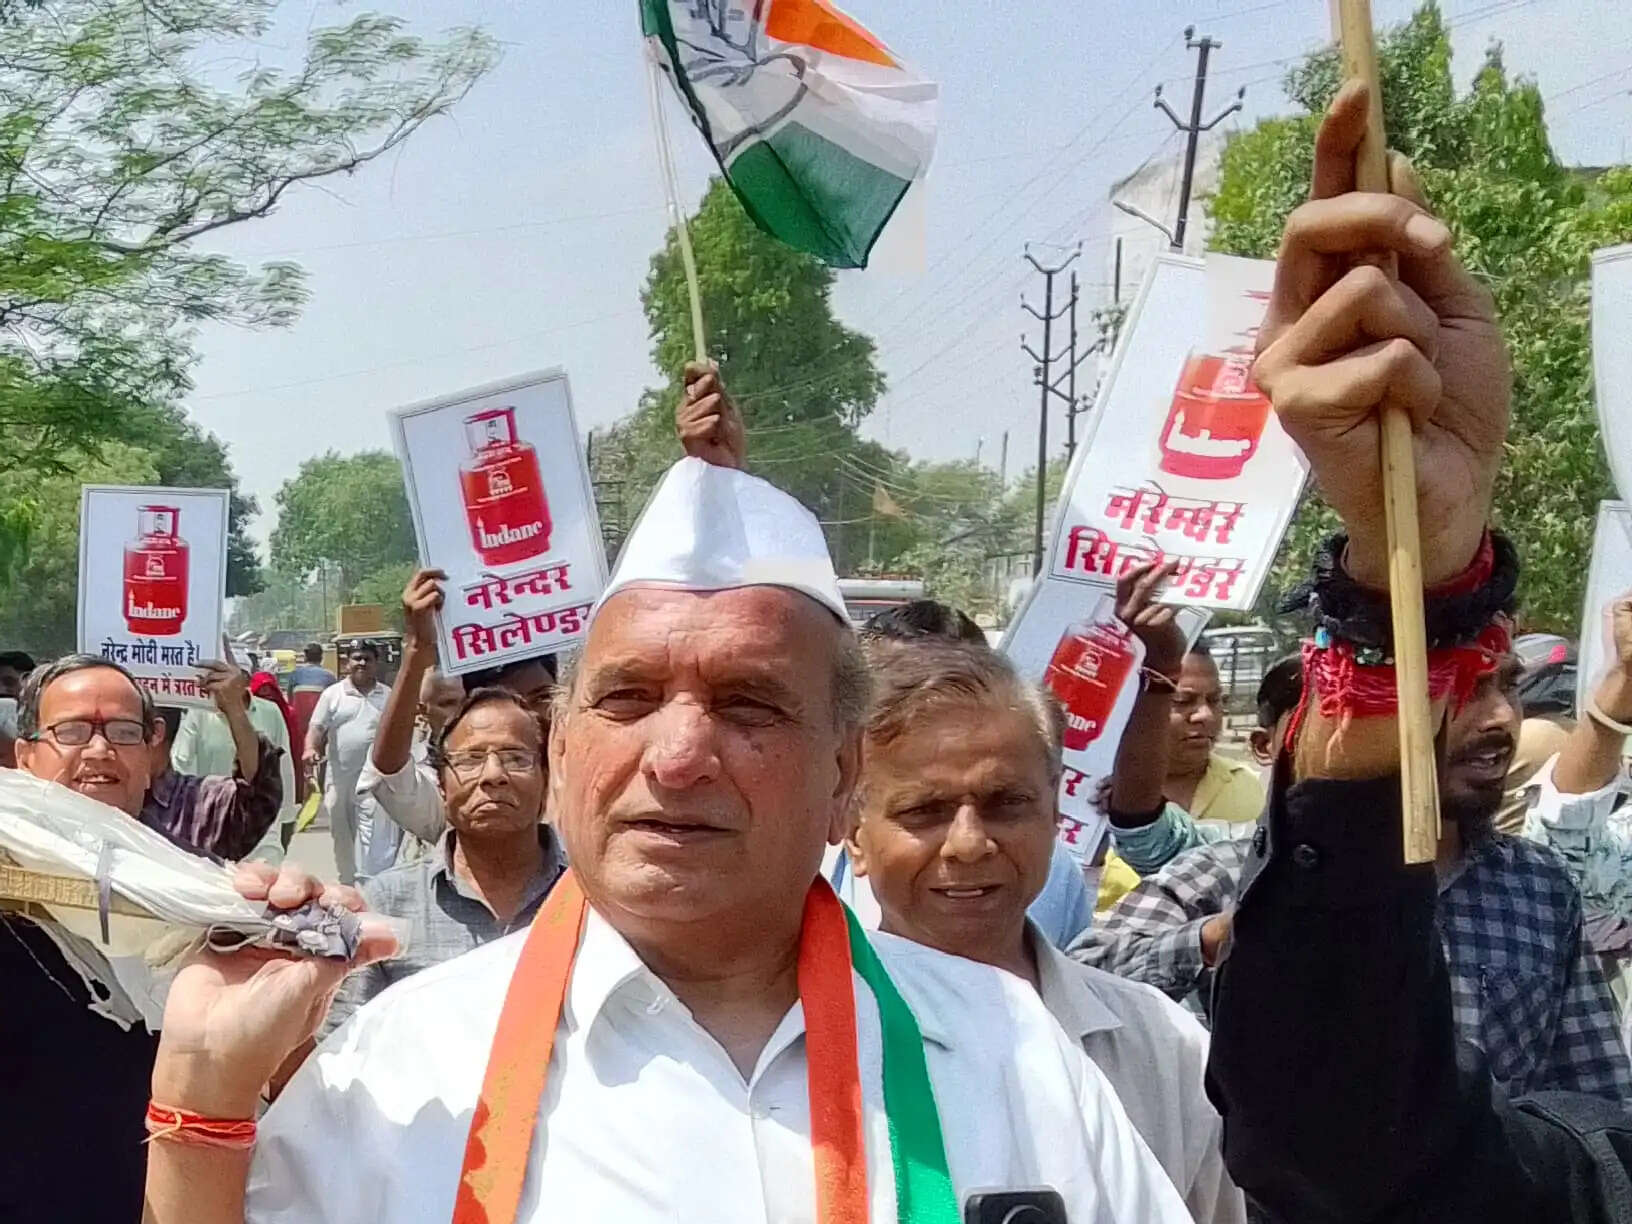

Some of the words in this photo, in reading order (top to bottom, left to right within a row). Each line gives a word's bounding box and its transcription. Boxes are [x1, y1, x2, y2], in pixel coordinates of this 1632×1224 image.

[463, 560, 572, 609] नरेन्दर
[101, 637, 128, 663] नरेन्द्र
[131, 638, 157, 664] मोदी
[161, 645, 184, 666] मस्त
